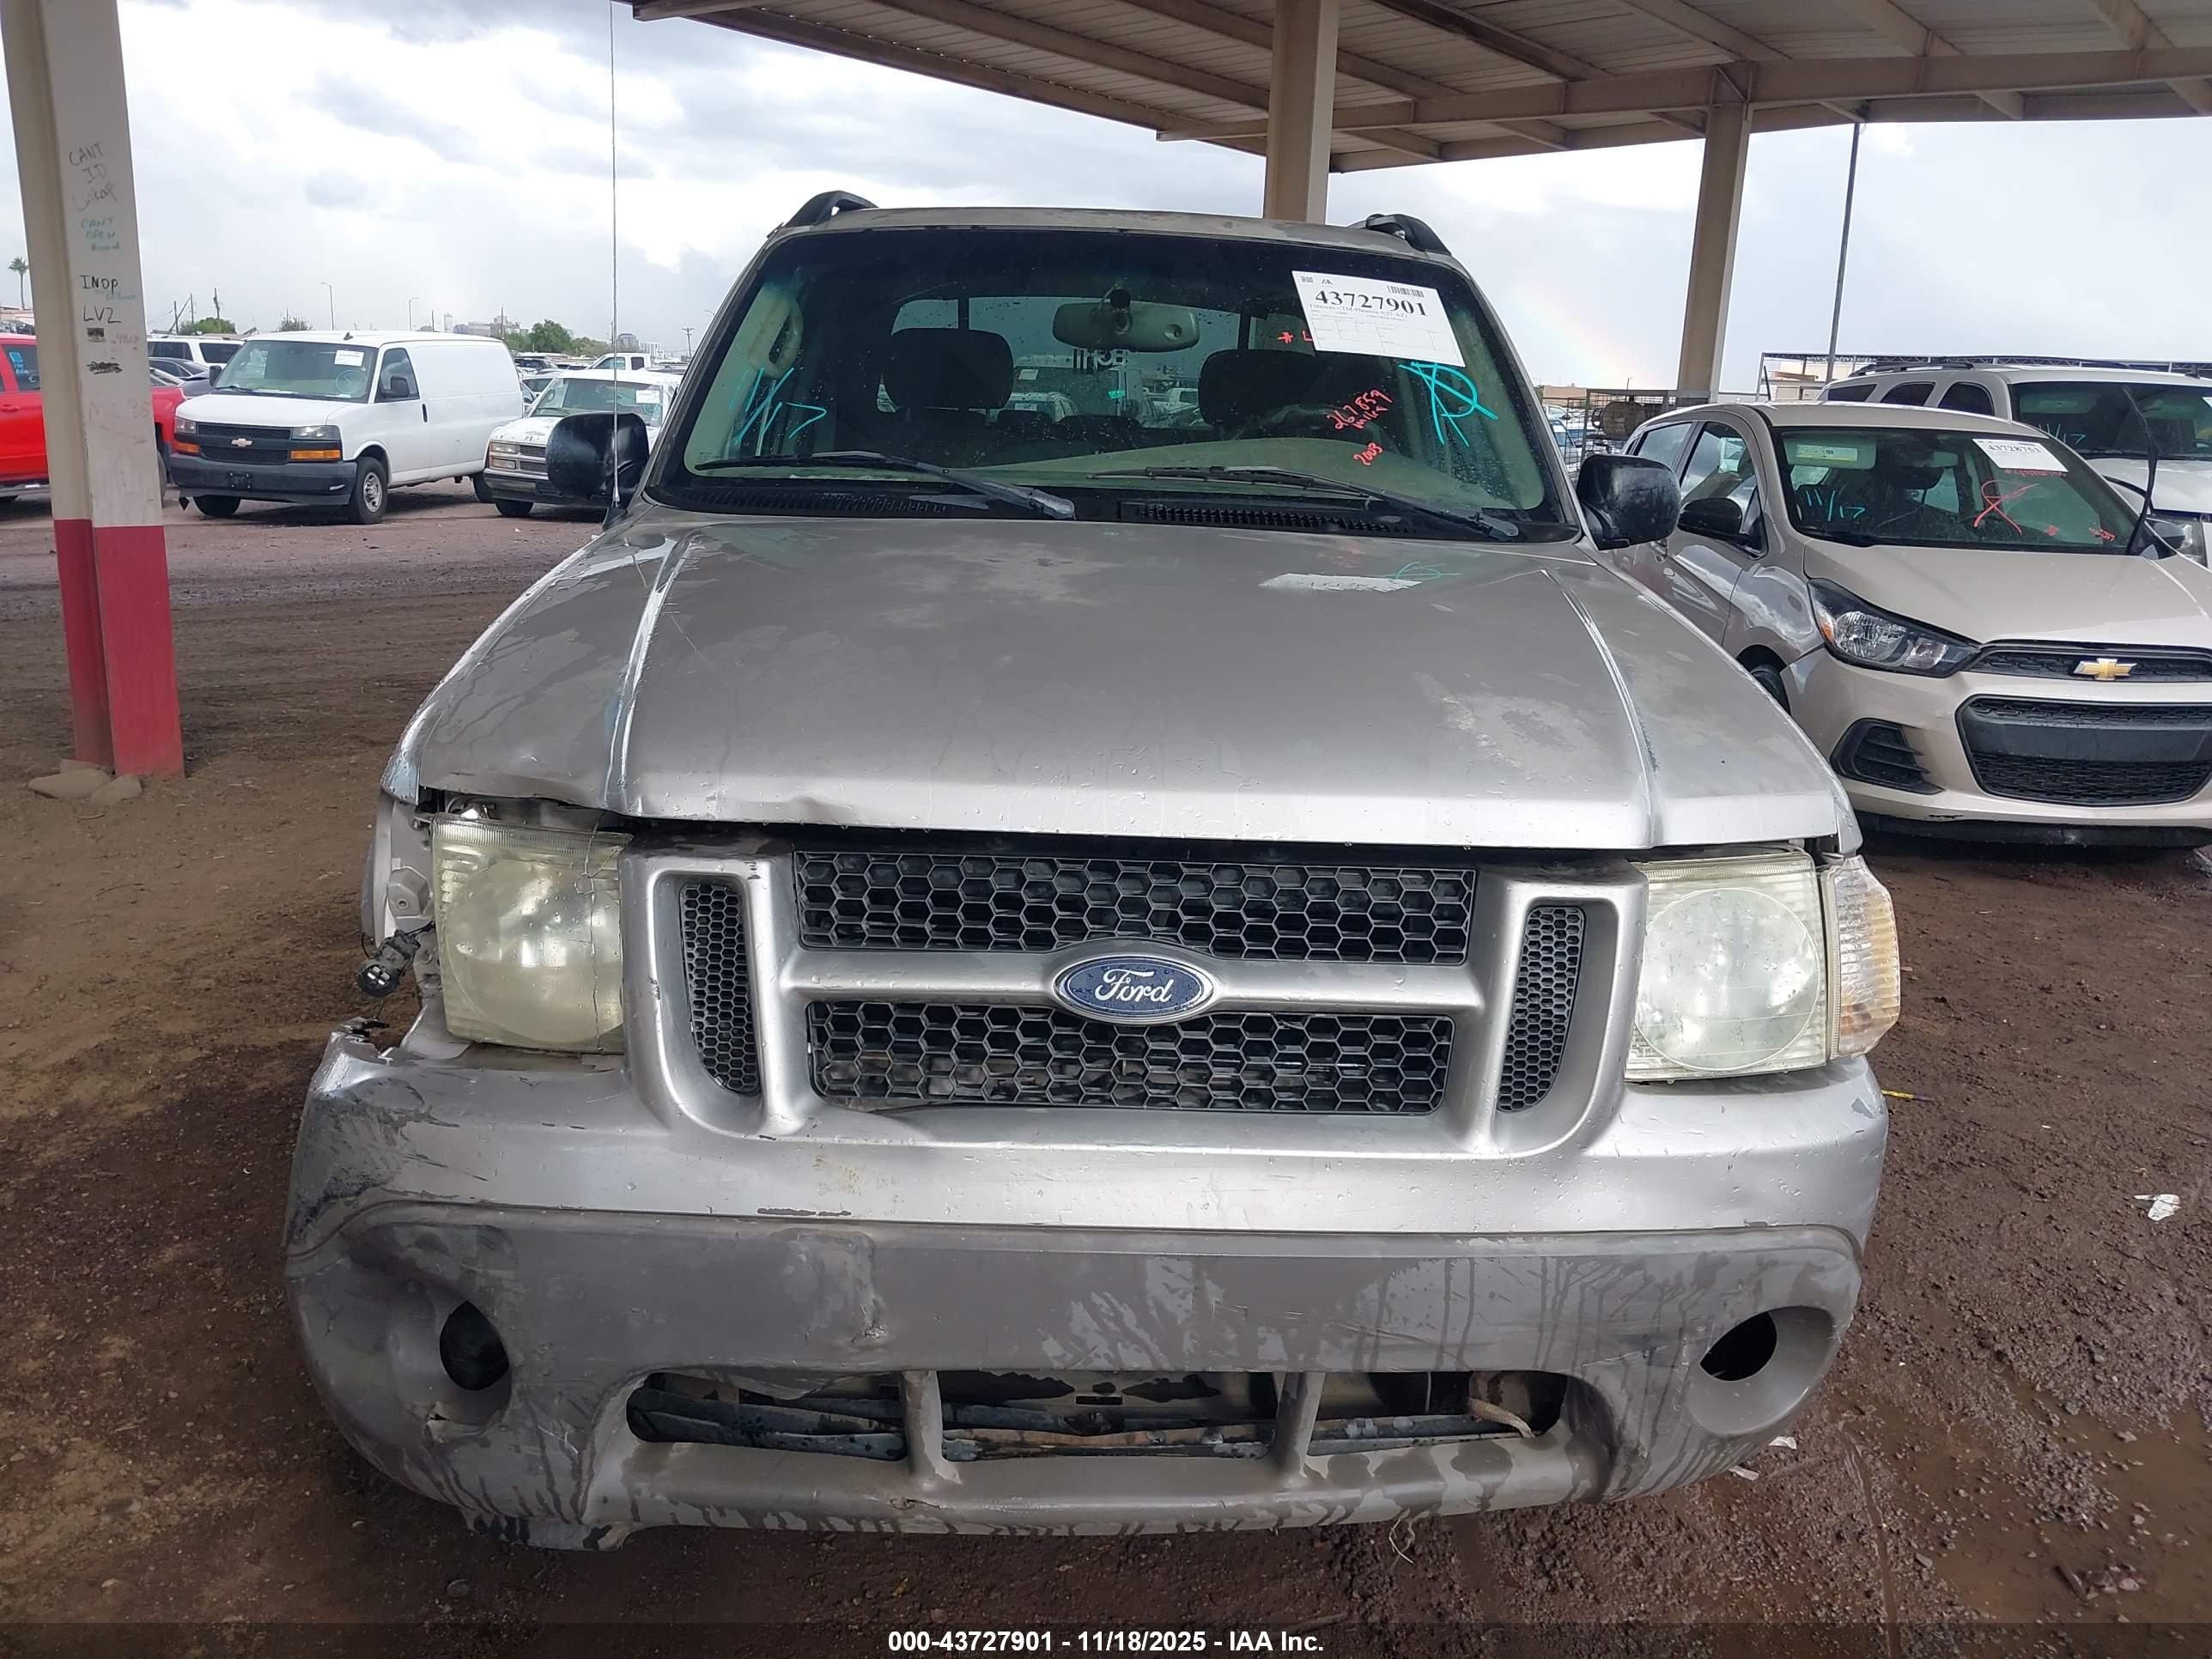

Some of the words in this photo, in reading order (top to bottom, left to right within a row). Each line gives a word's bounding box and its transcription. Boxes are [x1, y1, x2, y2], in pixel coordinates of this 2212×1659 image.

[1315, 289, 1429, 317] 43727901
[1805, 489, 1867, 522] 11/17
[1094, 968, 1175, 1003] Ford
